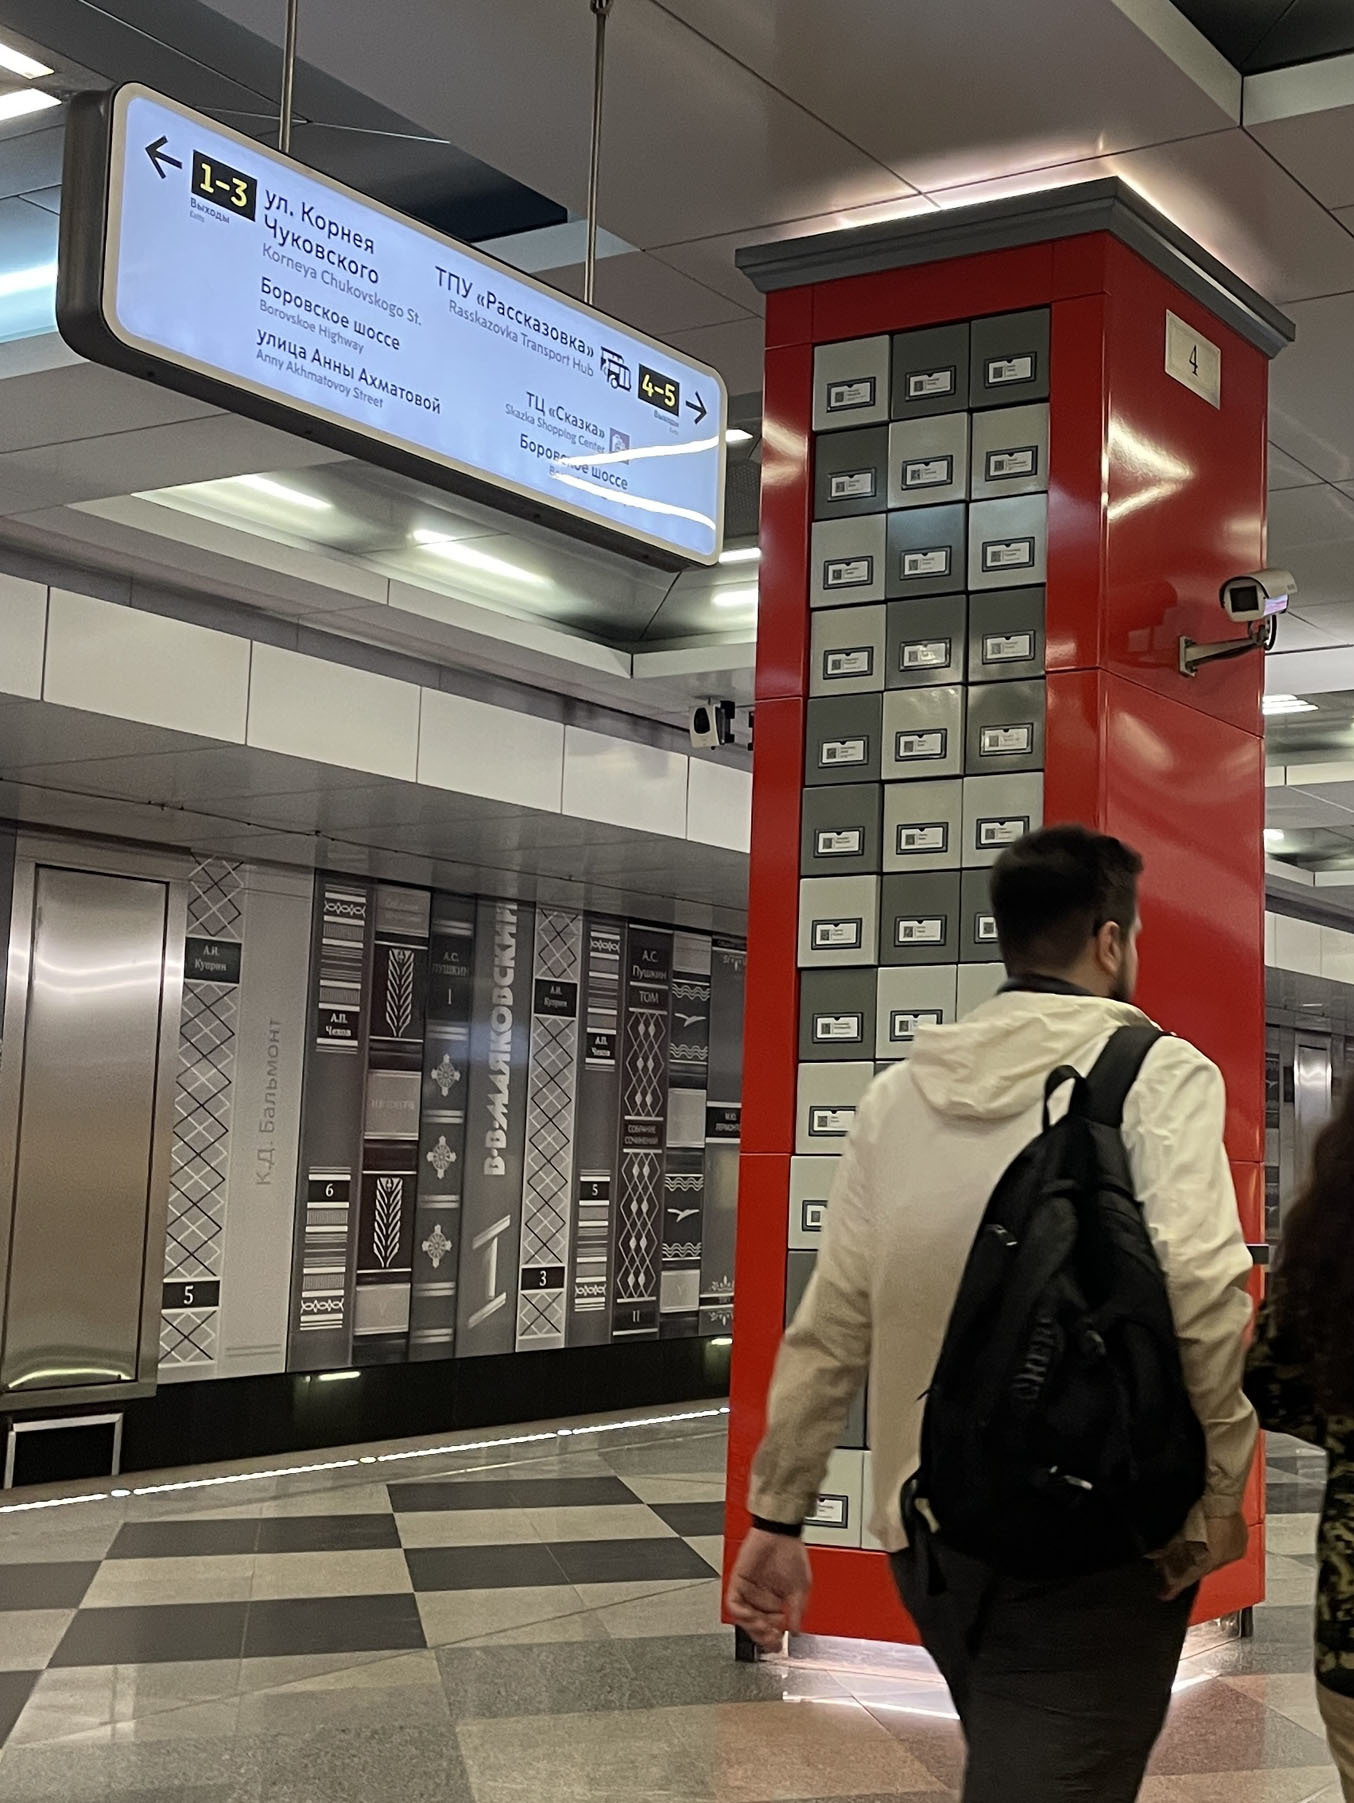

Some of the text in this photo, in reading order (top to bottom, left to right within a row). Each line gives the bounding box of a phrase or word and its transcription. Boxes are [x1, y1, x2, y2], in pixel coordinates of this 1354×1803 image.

[264, 189, 374, 254] ул. Корнея
[264, 214, 379, 284] Чуковского
[263, 243, 422, 326] Korneya Chukovskogo St.
[259, 299, 365, 355] Borovskoe Highway
[261, 276, 400, 350] Боровское шоссе
[435, 266, 594, 358] ТПУ «Рассказовка»
[449, 300, 594, 377] Rasskazovka Transport Hub
[256, 329, 441, 414] улица Анны Ахматовой
[256, 349, 383, 408] Anny Akhmatovoy Street
[1188, 345, 1198, 376] 4
[505, 403, 605, 454] Skazka Shopping Center
[526, 391, 605, 439] ТЦ «Сказка»
[591, 466, 628, 490] шоссе
[632, 965, 667, 979] Пушкин
[639, 990, 659, 1003] ТОМ
[259, 1018, 281, 1134] Бальмонт
[325, 1183, 334, 1197] 6
[592, 1183, 599, 1196] 5
[183, 1285, 194, 1305] 5
[539, 1270, 547, 1286] 3
